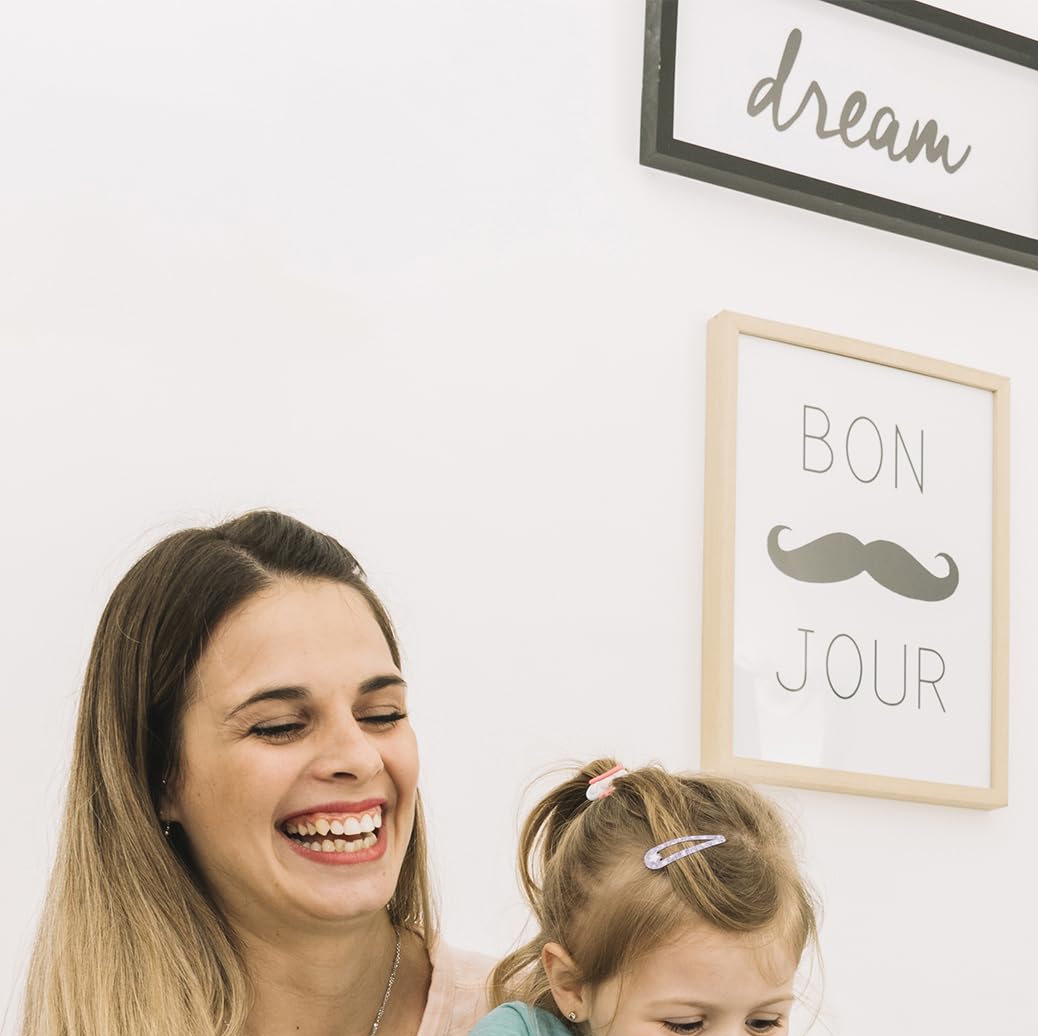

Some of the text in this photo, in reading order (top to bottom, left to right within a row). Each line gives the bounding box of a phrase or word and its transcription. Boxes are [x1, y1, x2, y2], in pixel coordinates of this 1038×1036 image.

[746, 27, 972, 174] dream
[802, 404, 924, 495] BON
[775, 627, 946, 713] JOUR
